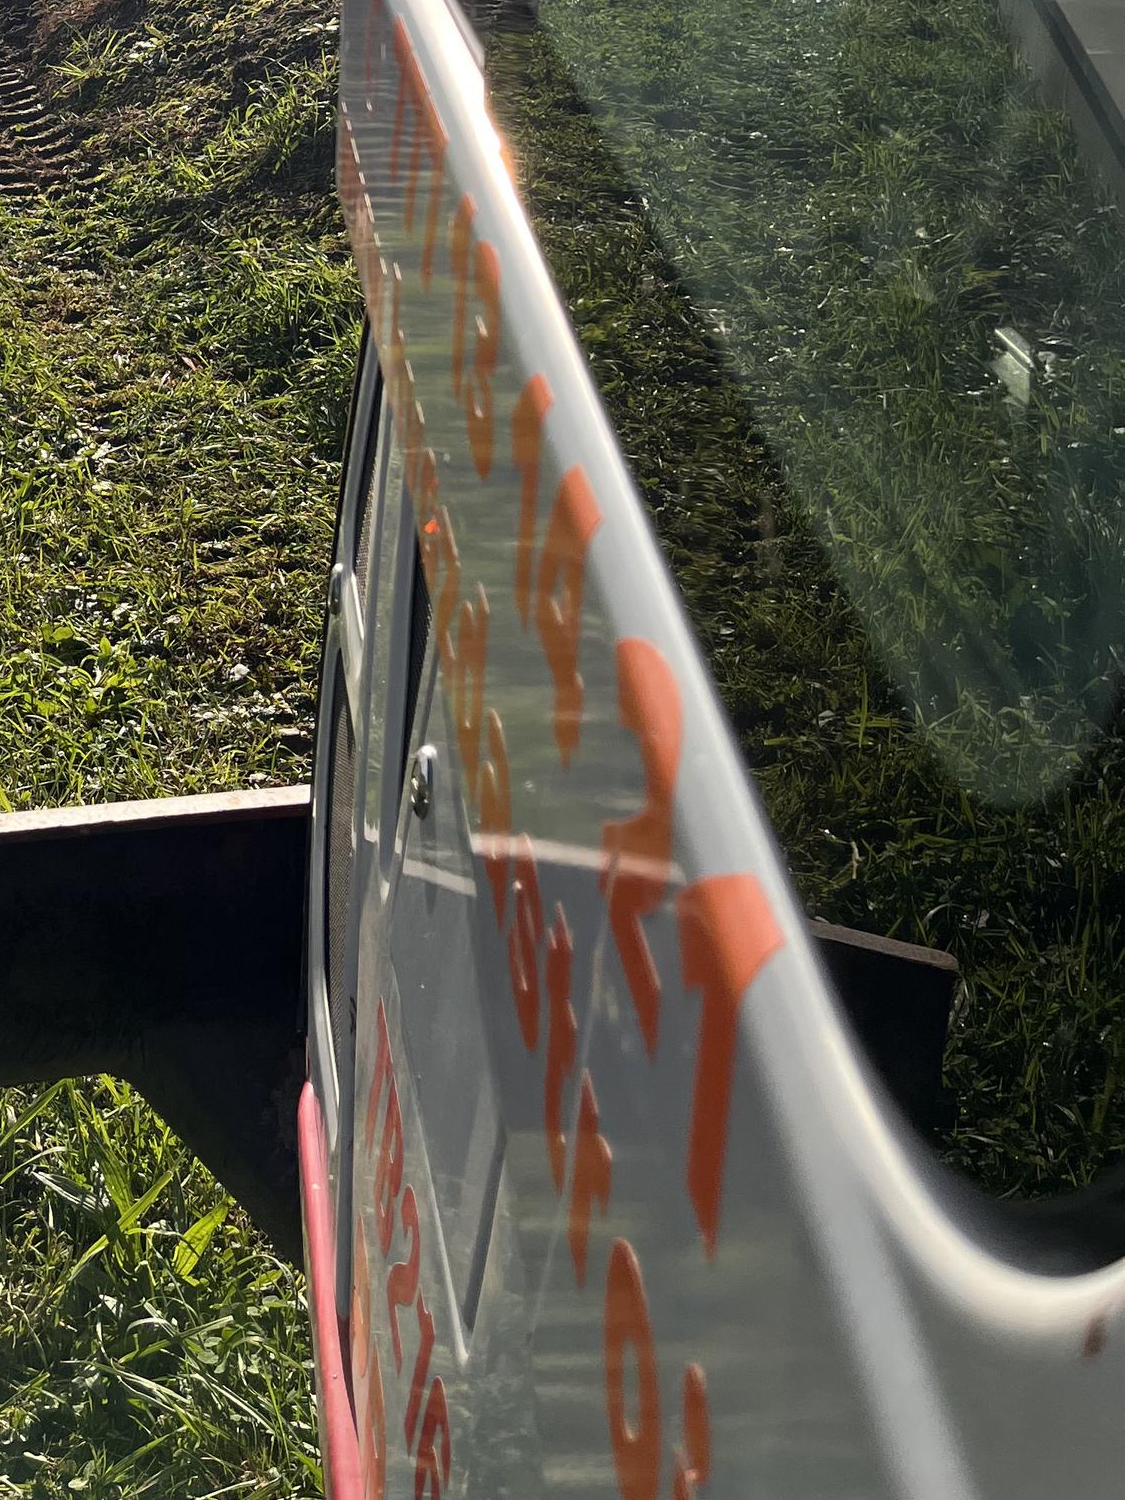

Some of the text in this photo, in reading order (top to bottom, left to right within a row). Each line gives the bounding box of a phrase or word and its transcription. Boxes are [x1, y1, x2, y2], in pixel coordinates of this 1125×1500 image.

[450, 191, 503, 482] 13
[512, 371, 603, 772] 14
[599, 636, 787, 1266] 21
